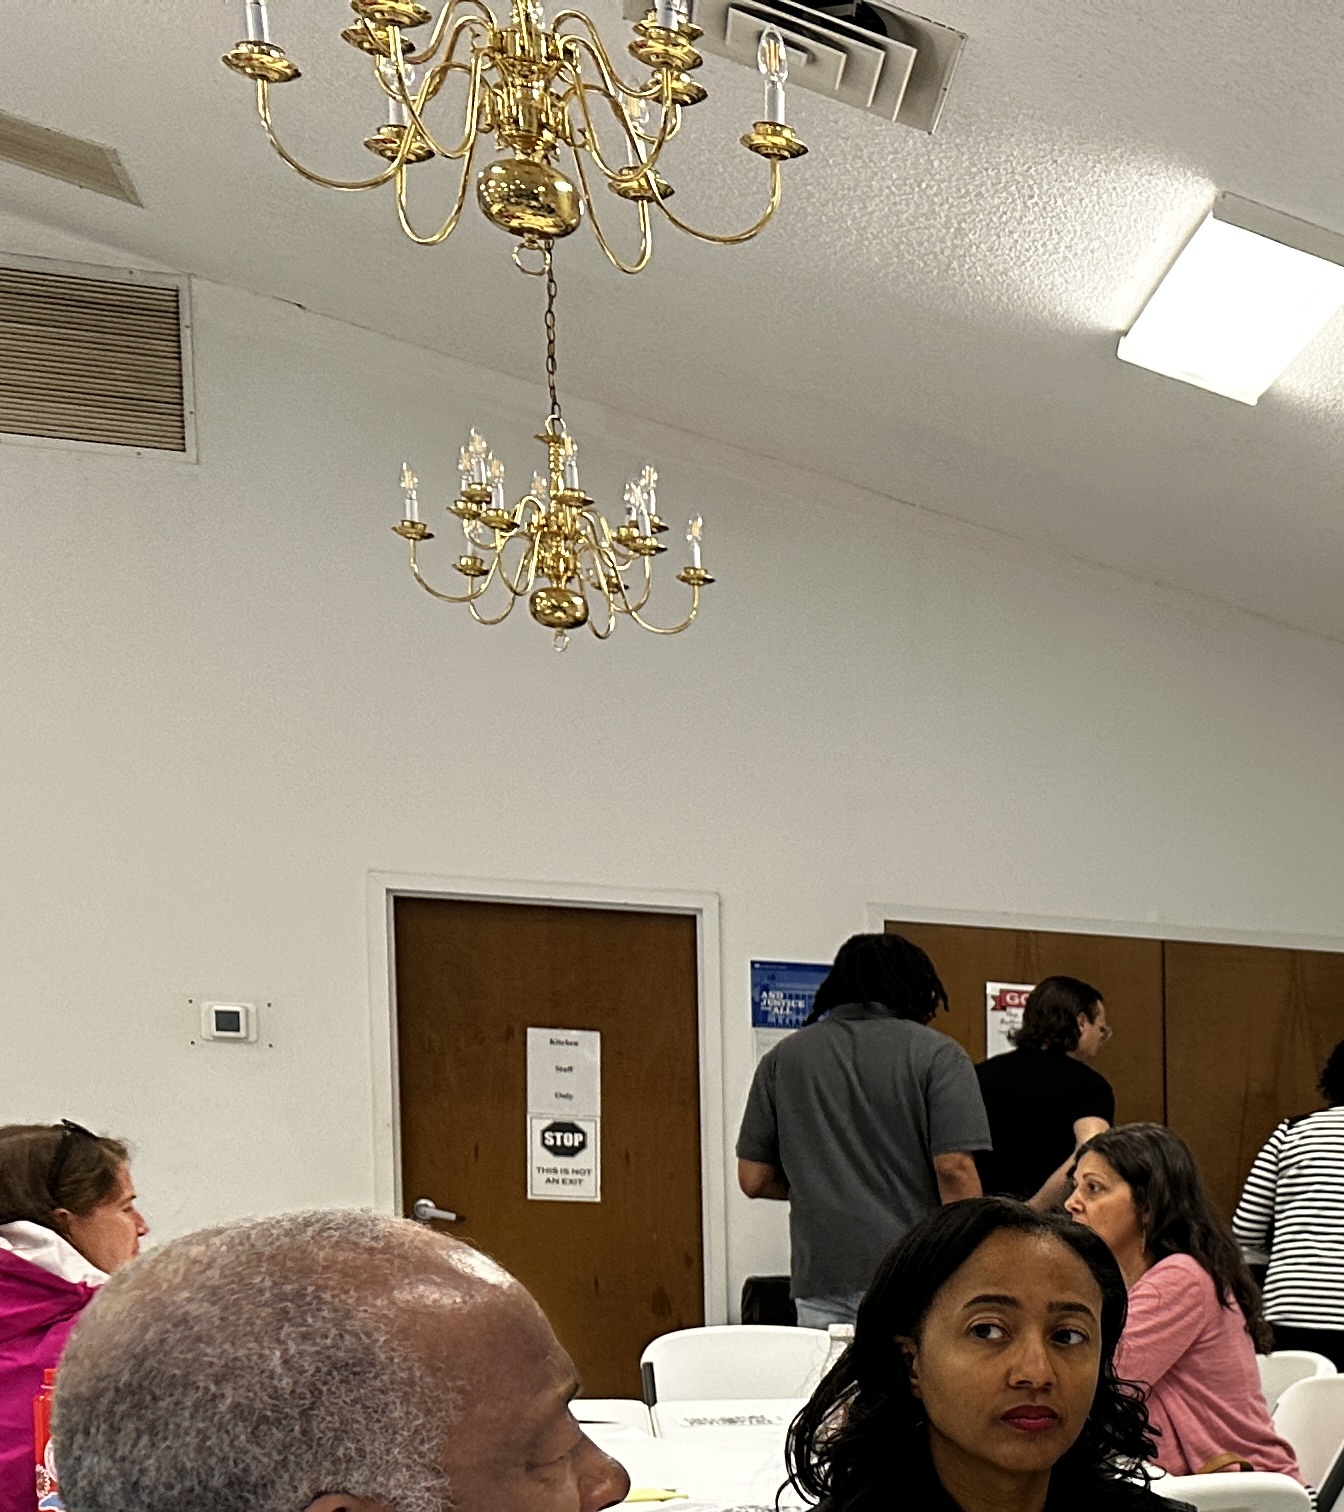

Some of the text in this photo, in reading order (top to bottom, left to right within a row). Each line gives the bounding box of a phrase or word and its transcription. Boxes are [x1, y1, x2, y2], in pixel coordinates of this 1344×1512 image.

[544, 1131, 584, 1147] STOP
[536, 1166, 592, 1176] THIS IS NOT
[545, 1177, 583, 1186] AN EXIT
